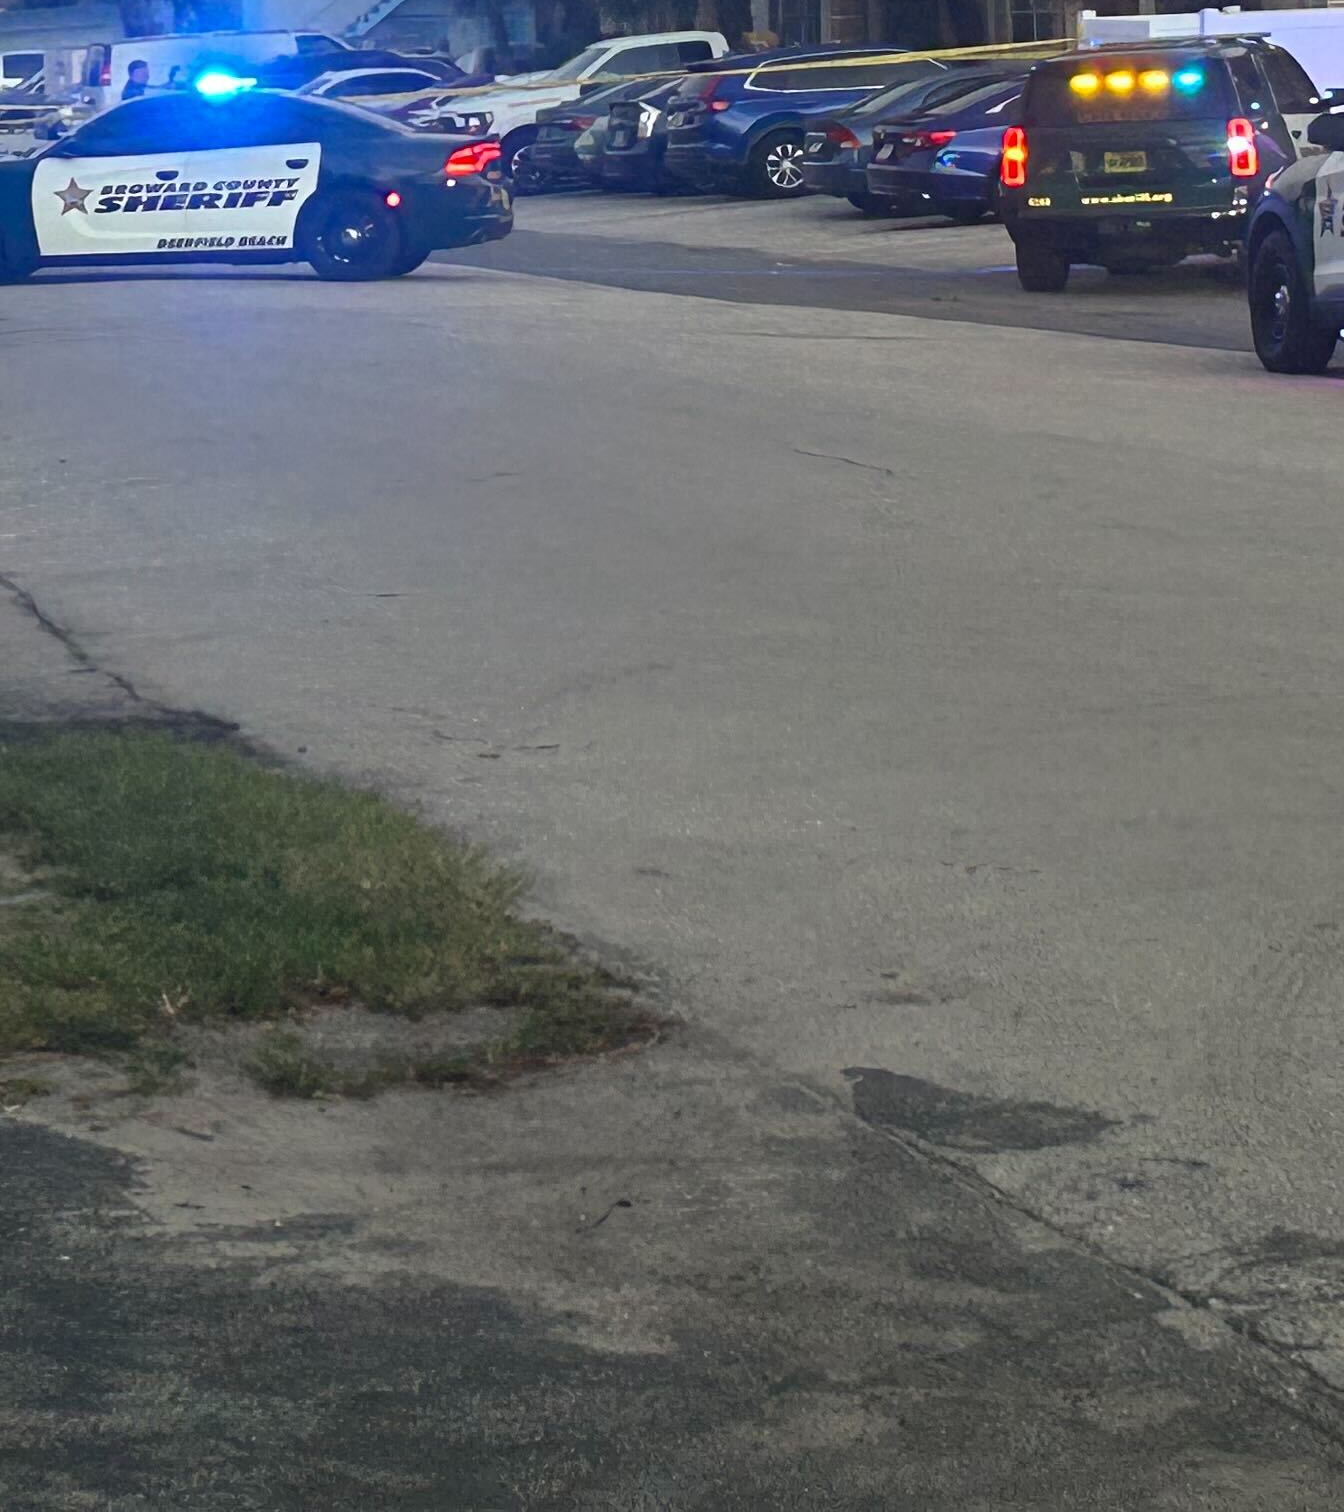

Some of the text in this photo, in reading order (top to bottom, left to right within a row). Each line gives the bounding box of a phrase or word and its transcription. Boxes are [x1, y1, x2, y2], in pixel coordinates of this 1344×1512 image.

[100, 177, 301, 196] BROWARD COUNTY
[94, 189, 299, 214] SHERIFF
